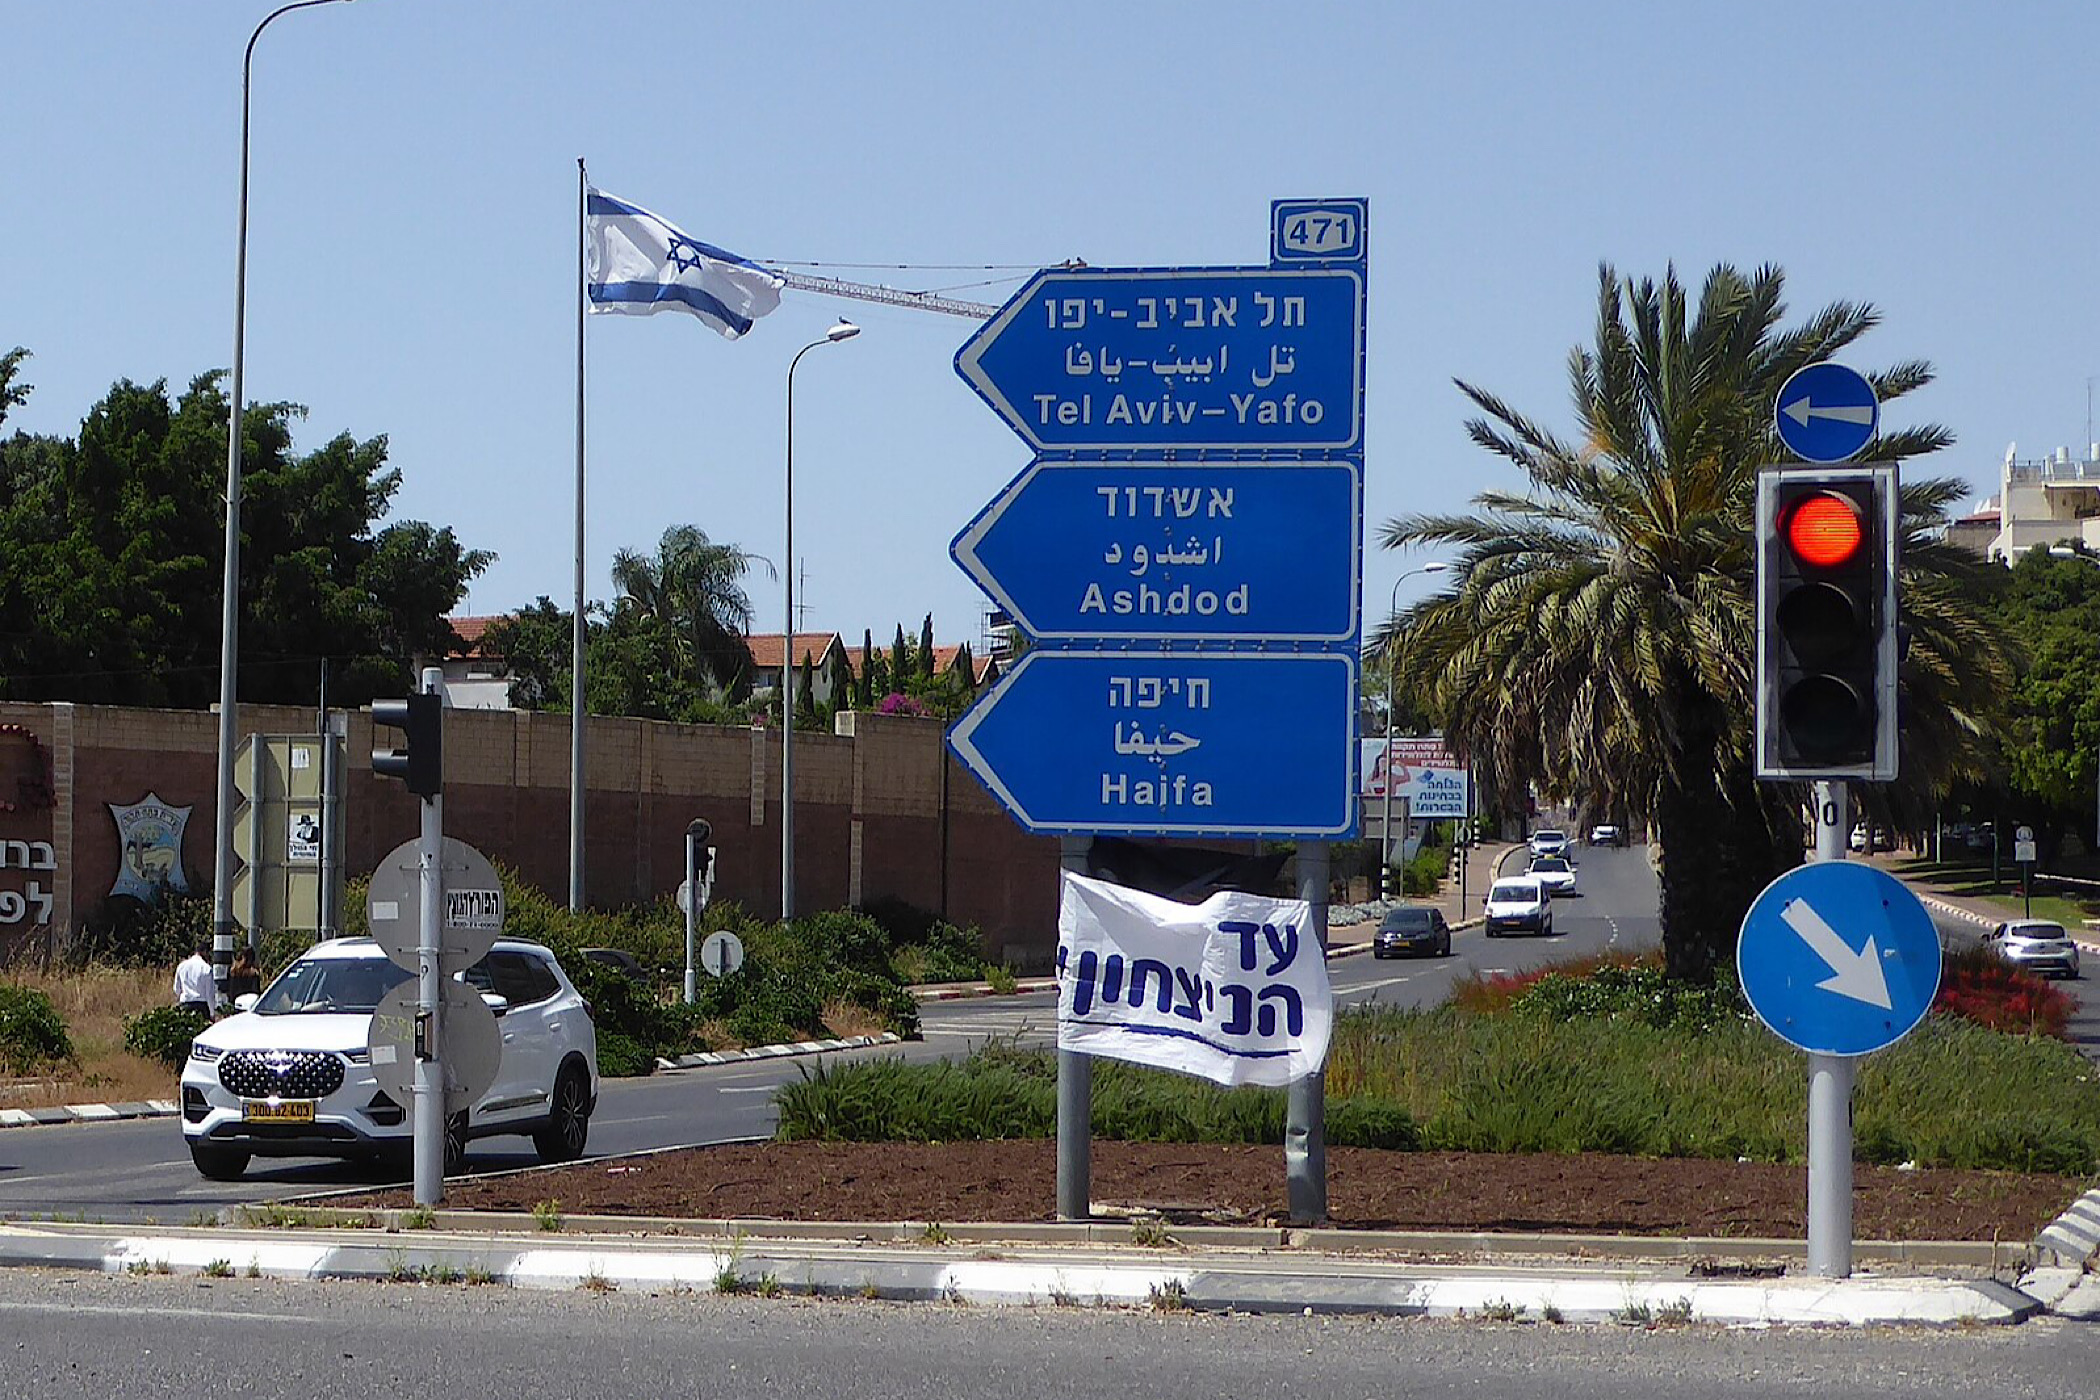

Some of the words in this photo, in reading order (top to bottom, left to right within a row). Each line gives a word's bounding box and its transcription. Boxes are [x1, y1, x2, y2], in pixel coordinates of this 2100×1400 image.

[1289, 217, 1348, 244] 471
[1254, 291, 1305, 327] תל
[1252, 345, 1295, 387] تل
[1033, 394, 1091, 424] Tel
[1097, 487, 1234, 517] אשדוד
[1105, 536, 1221, 576] اشدود
[1080, 583, 1249, 614] Ashdod
[1109, 677, 1210, 708] חיפה
[1114, 721, 1201, 763] حيفا
[1102, 774, 1213, 806] Haifa
[1217, 921, 1299, 977] עד
